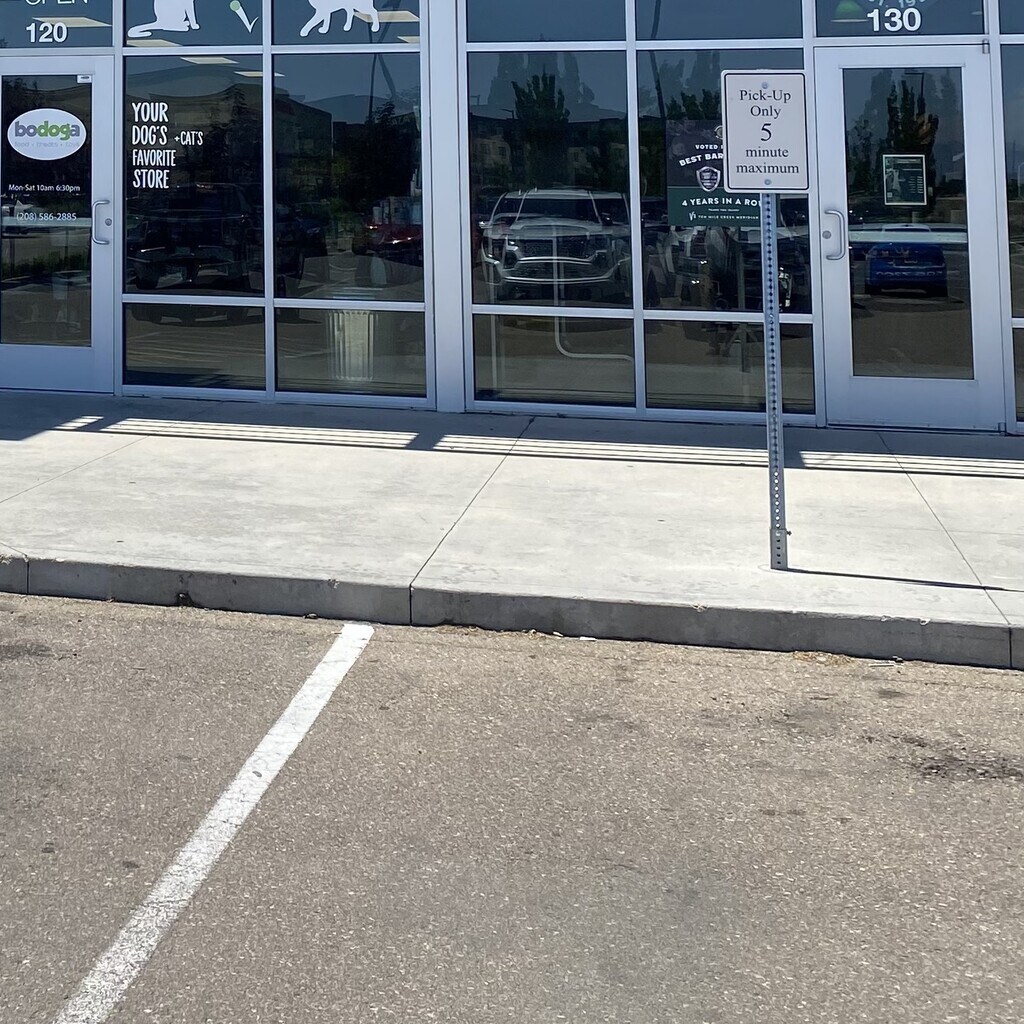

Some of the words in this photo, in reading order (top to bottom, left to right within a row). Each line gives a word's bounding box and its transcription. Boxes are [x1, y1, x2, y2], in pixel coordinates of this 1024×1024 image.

[866, 7, 922, 32] 130
[26, 22, 68, 43] 120
[739, 89, 792, 104] Pick-Up
[131, 102, 169, 123] YOUR
[750, 105, 782, 120] Only
[14, 120, 81, 141] bodoga
[131, 125, 168, 145] DOG'S
[760, 122, 773, 142] 5
[132, 149, 177, 167] FAVORITE
[745, 146, 789, 158] minute
[679, 155, 702, 167] BEST
[736, 162, 800, 174] maximum
[132, 169, 170, 189] STORE
[55, 184, 80, 193] 6:30pm
[681, 199, 688, 207] 4
[689, 198, 719, 206] YEARS
[16, 212, 37, 221] (208)
[39, 212, 77, 221] 586-2885
